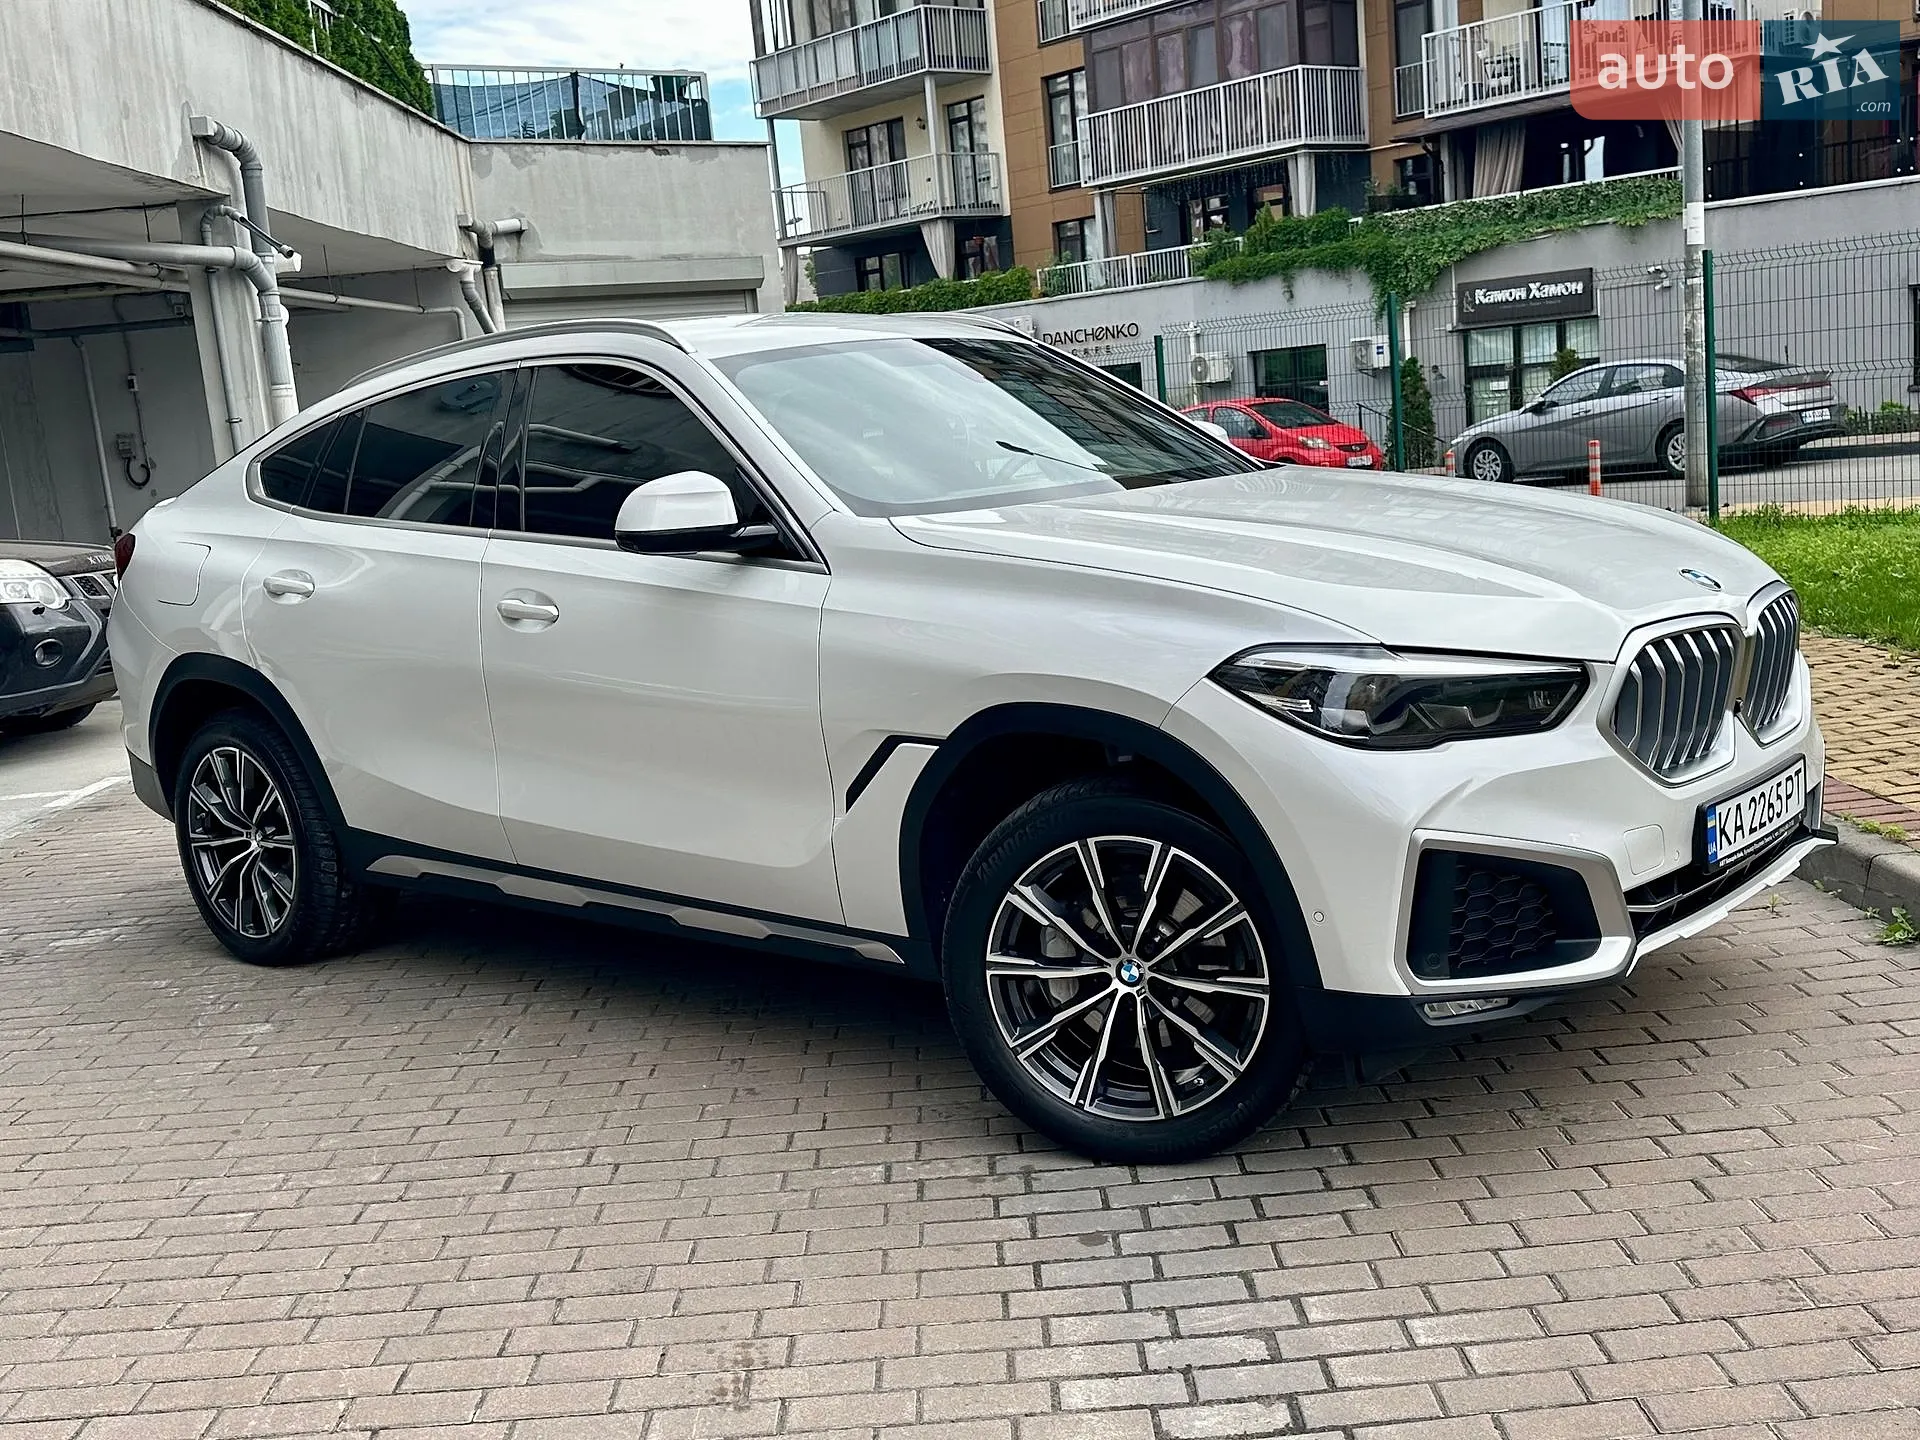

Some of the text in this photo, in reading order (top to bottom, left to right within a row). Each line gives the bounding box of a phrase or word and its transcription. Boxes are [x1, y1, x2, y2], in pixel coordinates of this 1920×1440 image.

[1474, 288, 1527, 305] Камон
[1528, 281, 1584, 299] Хамон
[1718, 802, 1746, 851] KA
[1748, 780, 1783, 835] 2265
[1708, 841, 1717, 855] UA
